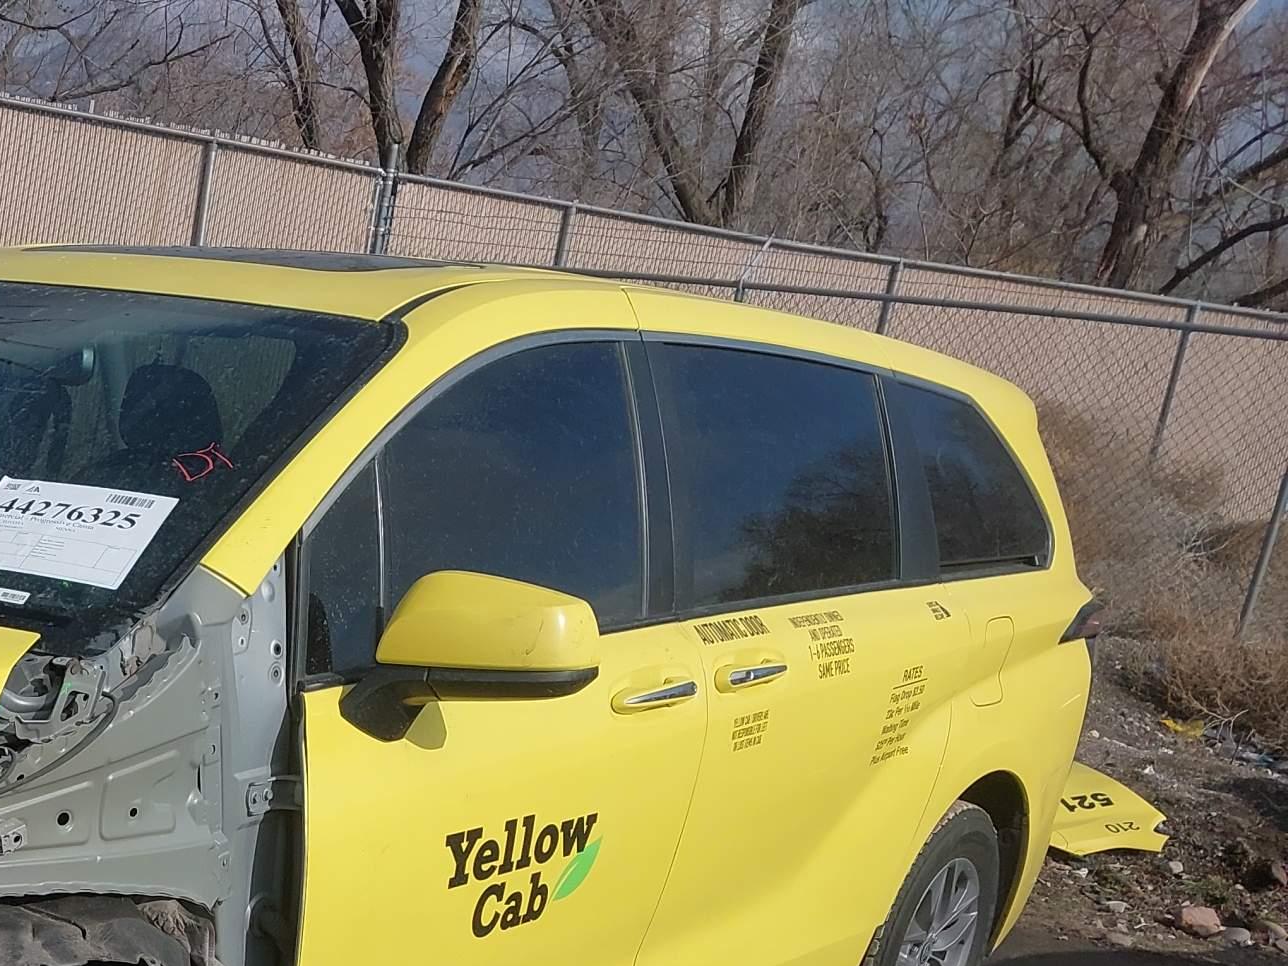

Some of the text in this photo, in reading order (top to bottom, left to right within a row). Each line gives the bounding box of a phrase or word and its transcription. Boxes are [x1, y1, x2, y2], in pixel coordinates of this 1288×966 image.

[693, 614, 771, 646] AUTOMATIC DOOR
[819, 638, 855, 659] PASSENGERS
[818, 658, 850, 679] SAME PRICE
[903, 665, 924, 682] RATES
[1060, 792, 1114, 812] 521
[1104, 821, 1140, 833] 210
[445, 812, 598, 889] Yellow
[472, 871, 548, 938] Cab
